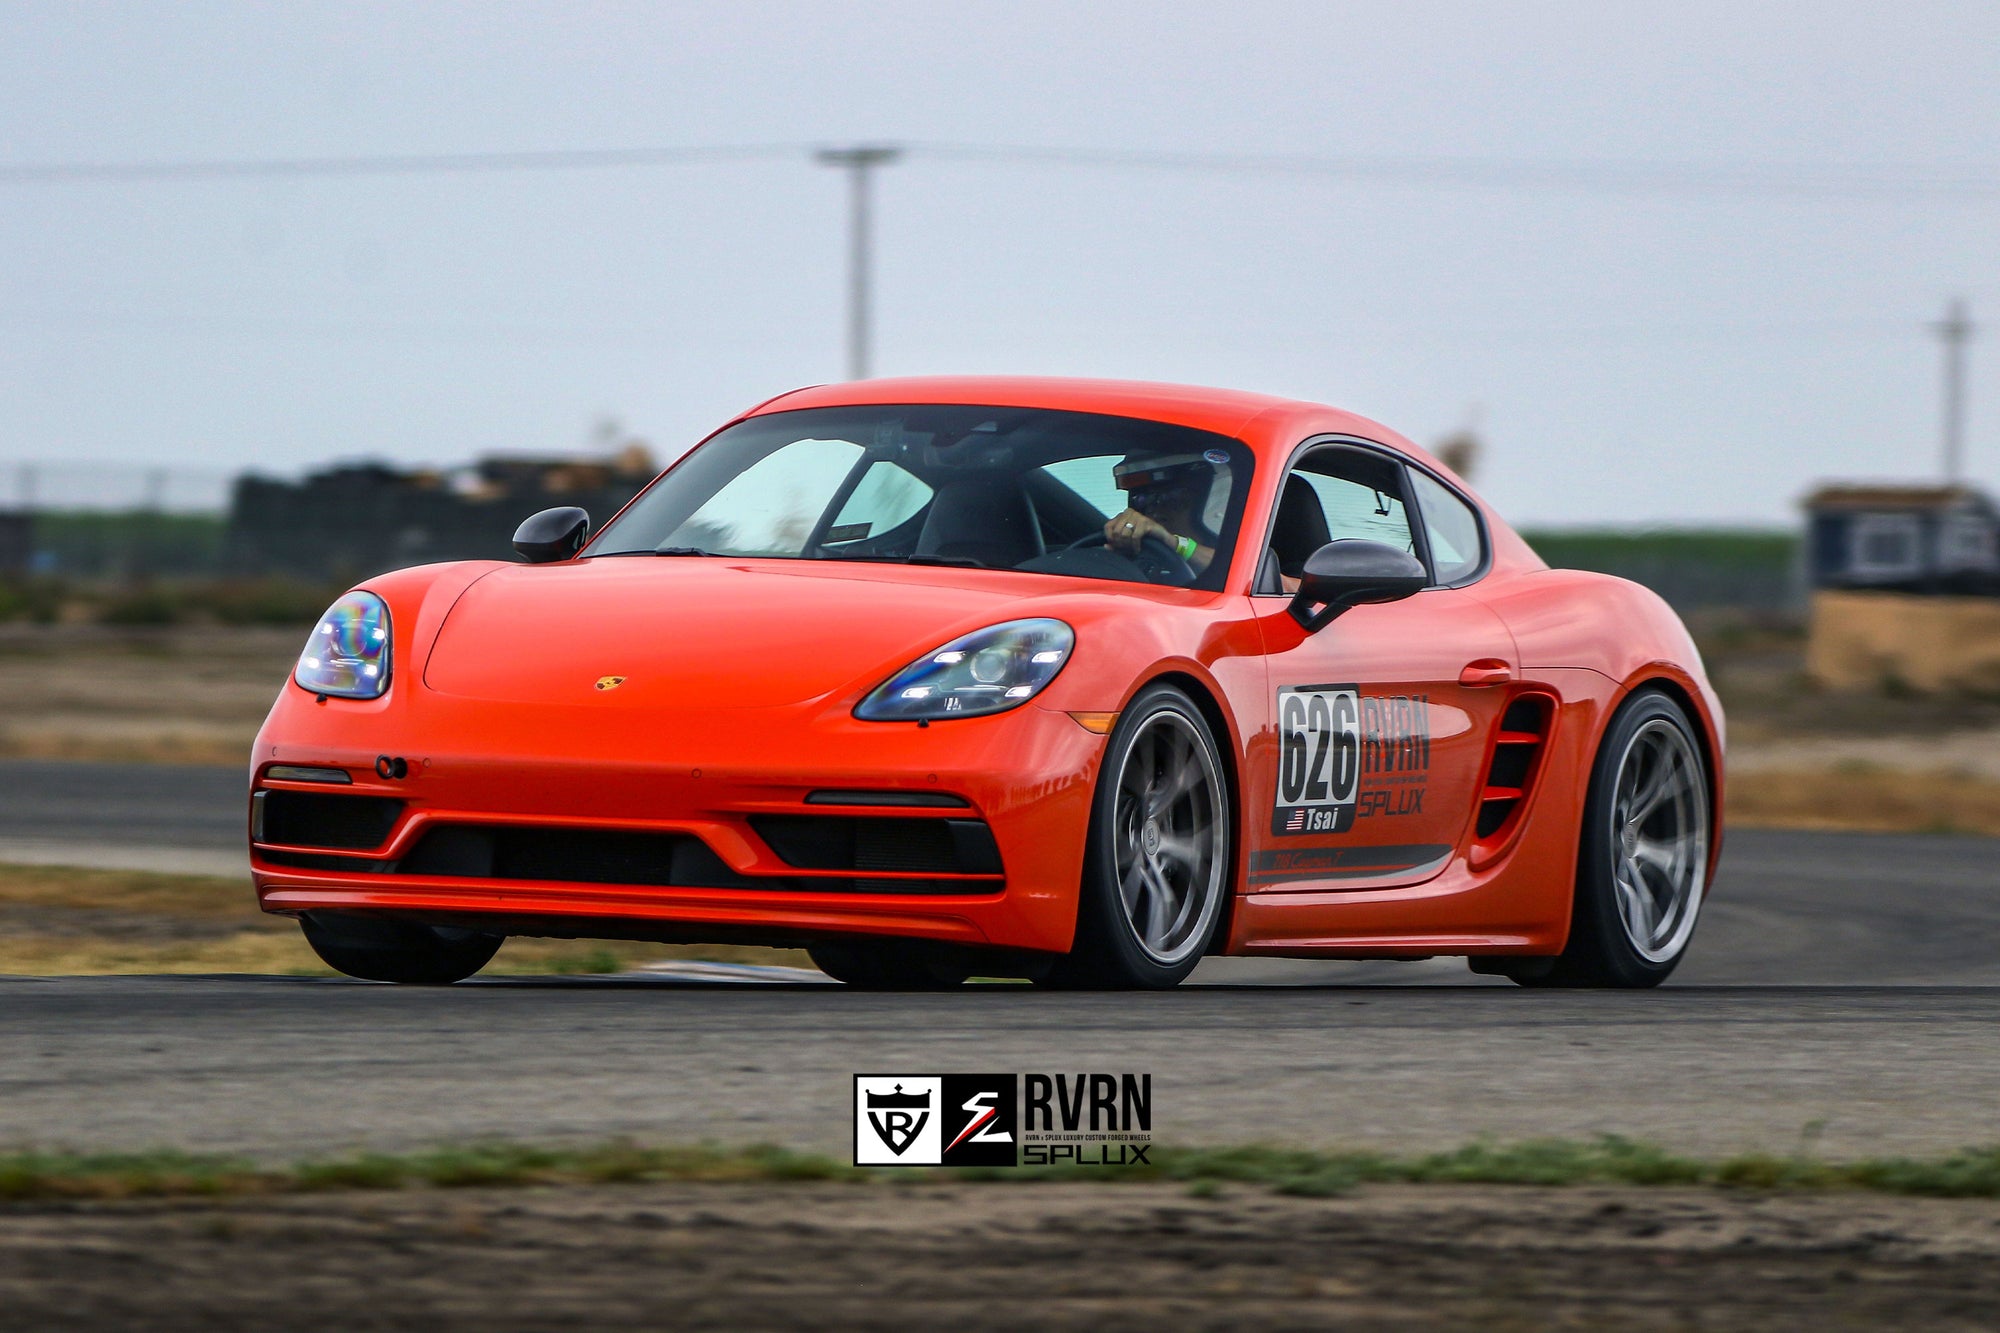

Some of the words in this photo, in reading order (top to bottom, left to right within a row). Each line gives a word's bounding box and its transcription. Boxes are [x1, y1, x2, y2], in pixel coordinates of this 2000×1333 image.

[1282, 694, 1356, 803] 626
[1363, 694, 1429, 773] RVRN
[1306, 807, 1339, 831] Tsai
[1358, 788, 1427, 818] SPLUX
